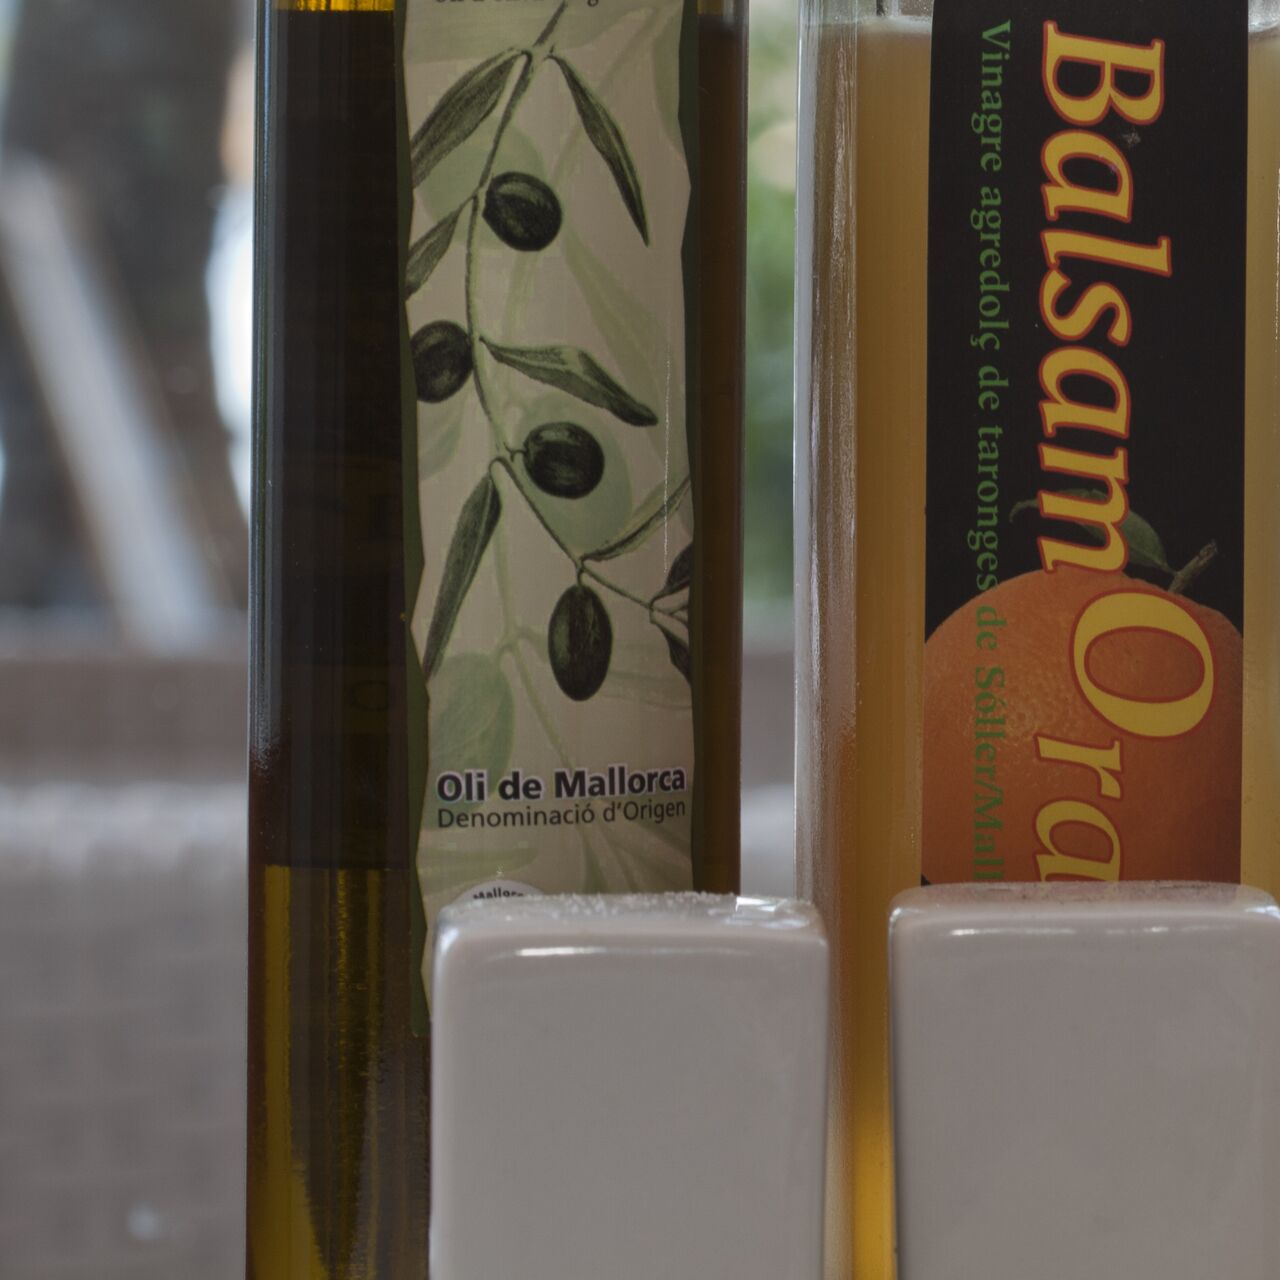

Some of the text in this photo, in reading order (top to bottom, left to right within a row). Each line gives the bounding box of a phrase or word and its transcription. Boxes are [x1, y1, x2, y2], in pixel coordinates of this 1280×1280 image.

[971, 19, 1011, 172] Vinagre
[970, 185, 1010, 351] agredolç
[977, 365, 1009, 411] de
[968, 425, 1002, 592] taronges
[976, 605, 1007, 650] de
[437, 766, 687, 802] Oli de Mallorca
[437, 803, 595, 828] Denominació
